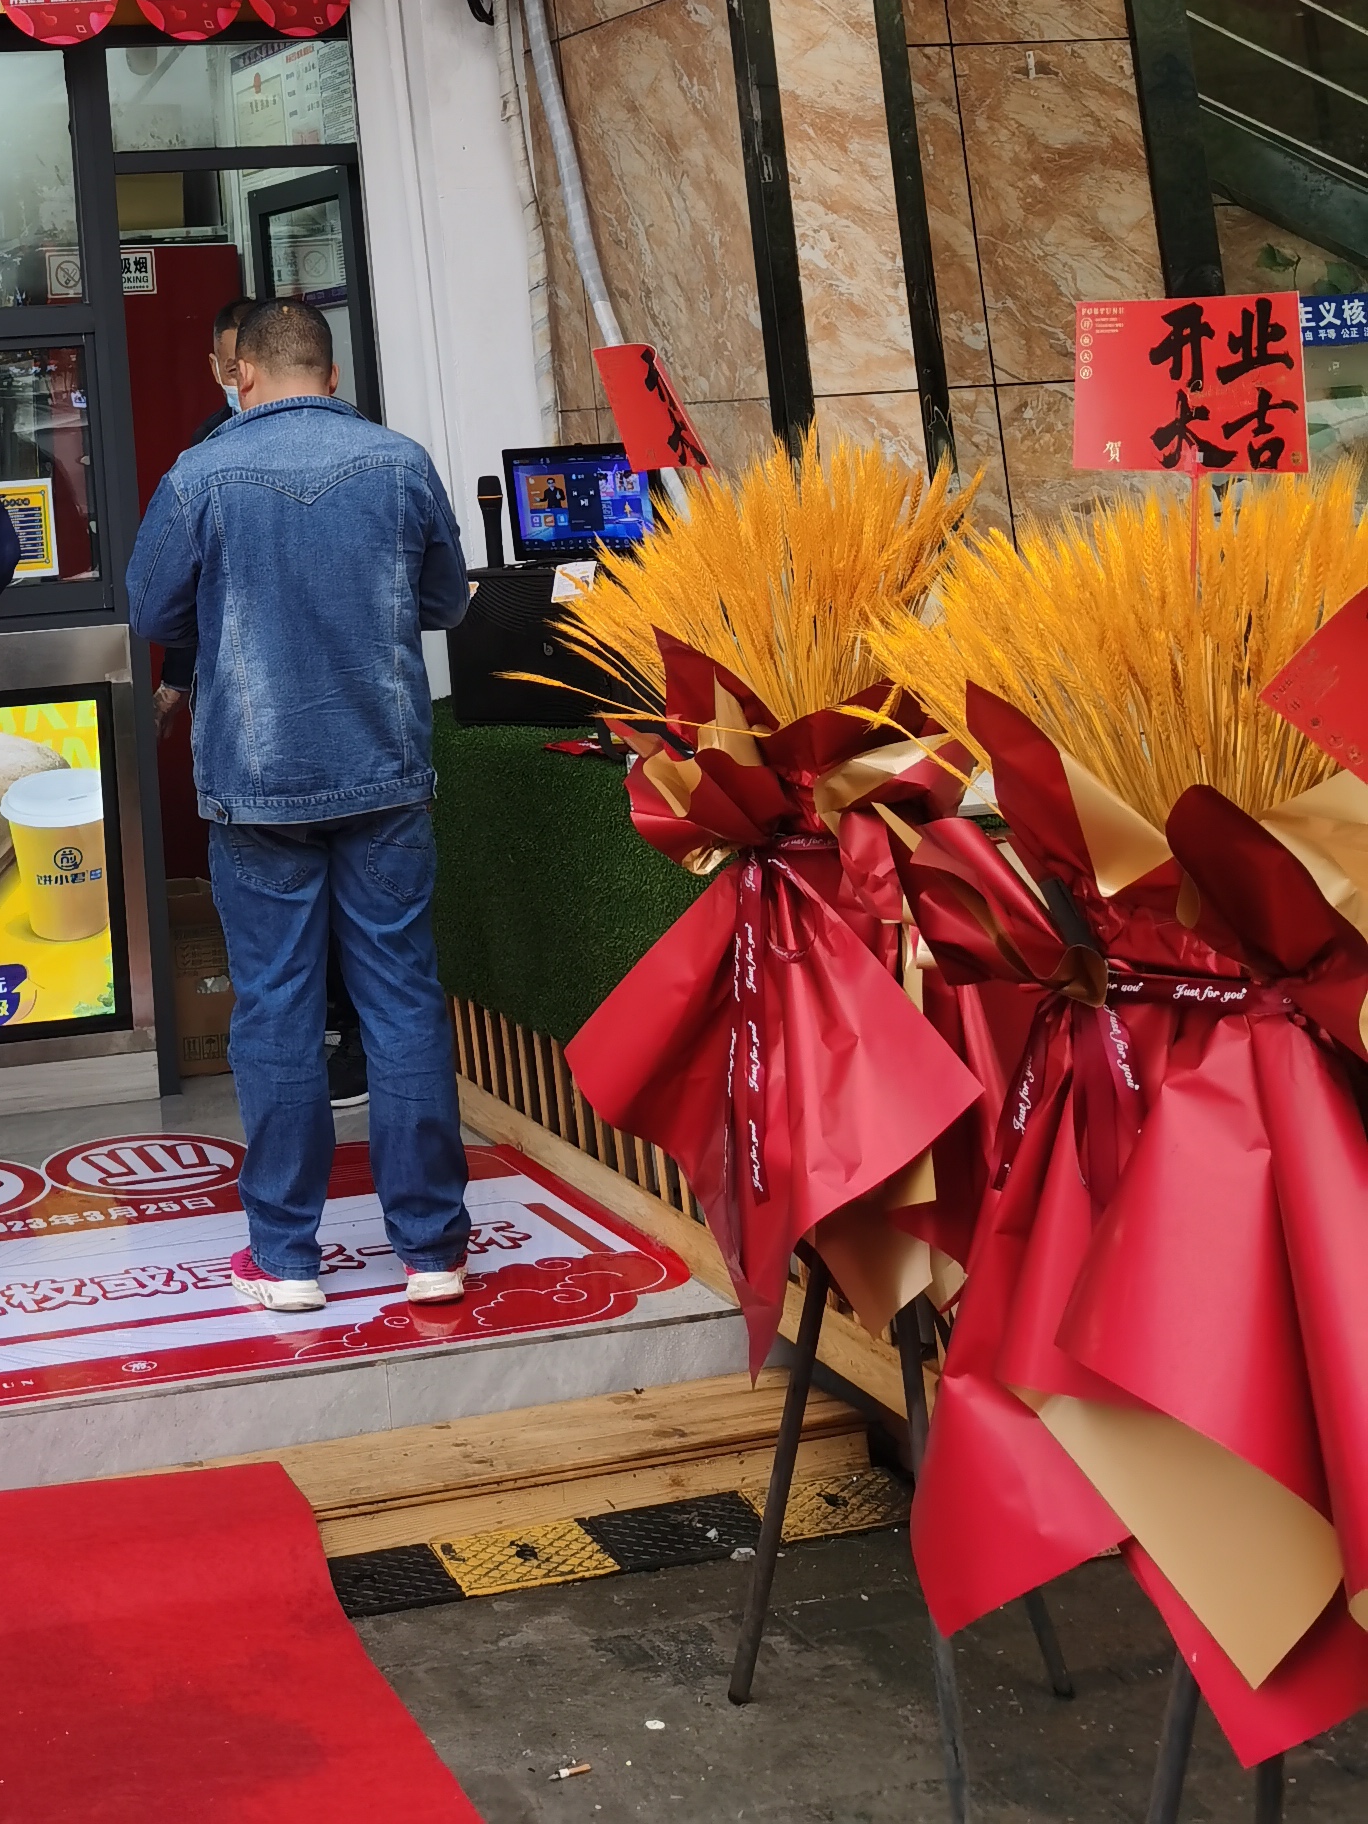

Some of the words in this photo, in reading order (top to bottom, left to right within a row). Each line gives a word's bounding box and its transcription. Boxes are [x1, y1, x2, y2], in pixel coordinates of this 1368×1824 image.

[1173, 984, 1199, 999] Just
[1197, 986, 1220, 1001] for
[1221, 989, 1246, 1002] you
